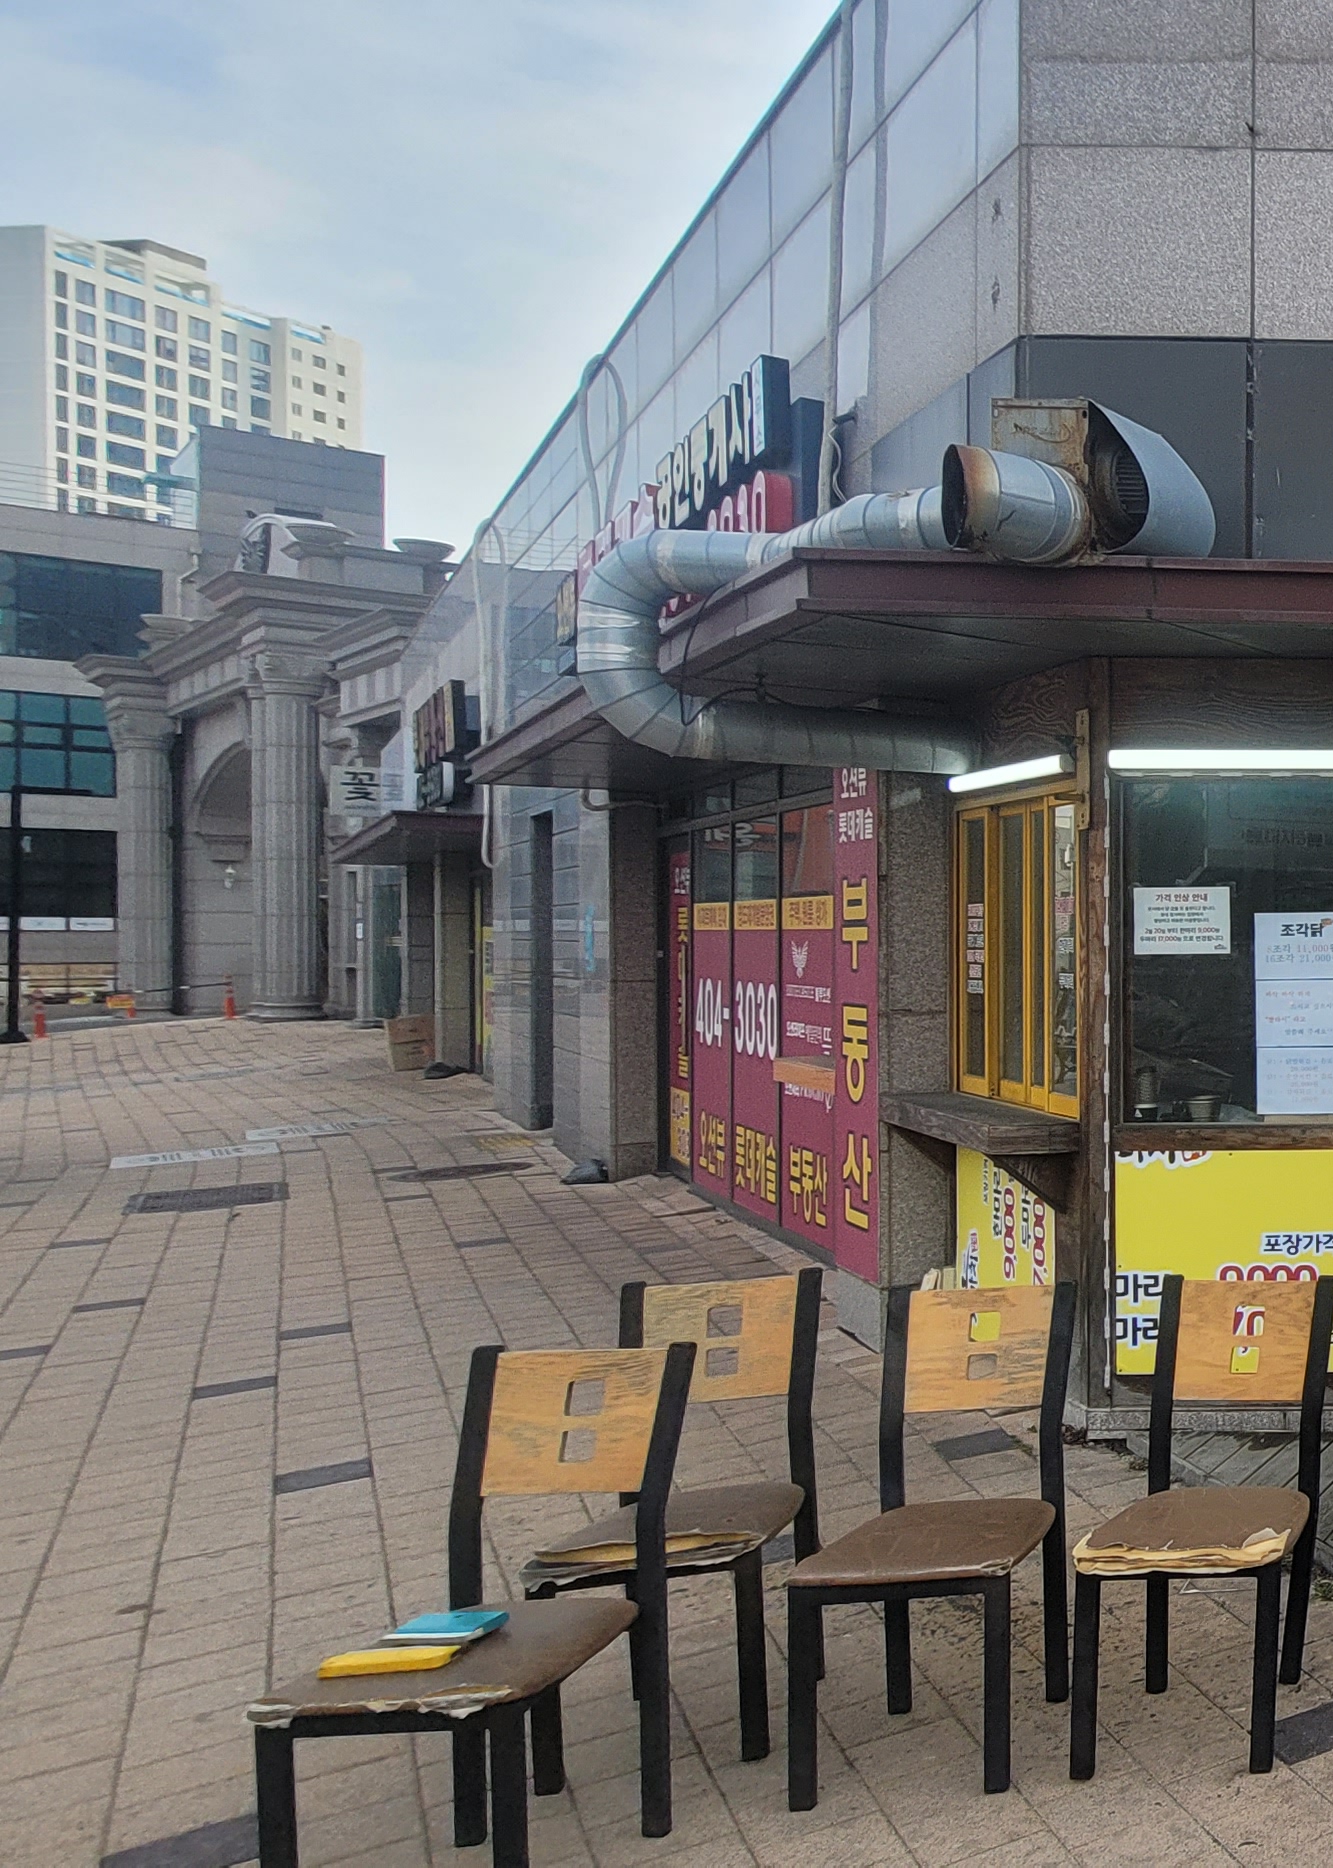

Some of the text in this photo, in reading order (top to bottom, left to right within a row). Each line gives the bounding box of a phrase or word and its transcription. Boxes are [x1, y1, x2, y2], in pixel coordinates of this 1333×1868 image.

[840, 767, 868, 799] 오션뷰
[1156, 893, 1208, 902] 가격 인상 안내
[1280, 923, 1324, 937] 조각닭
[841, 878, 872, 1230] 부동산
[698, 1109, 828, 1227] 오션뷰 롯데캐슬 부동산
[1003, 1188, 1017, 1280] 9,000
[1033, 1197, 1048, 1286] 7,000
